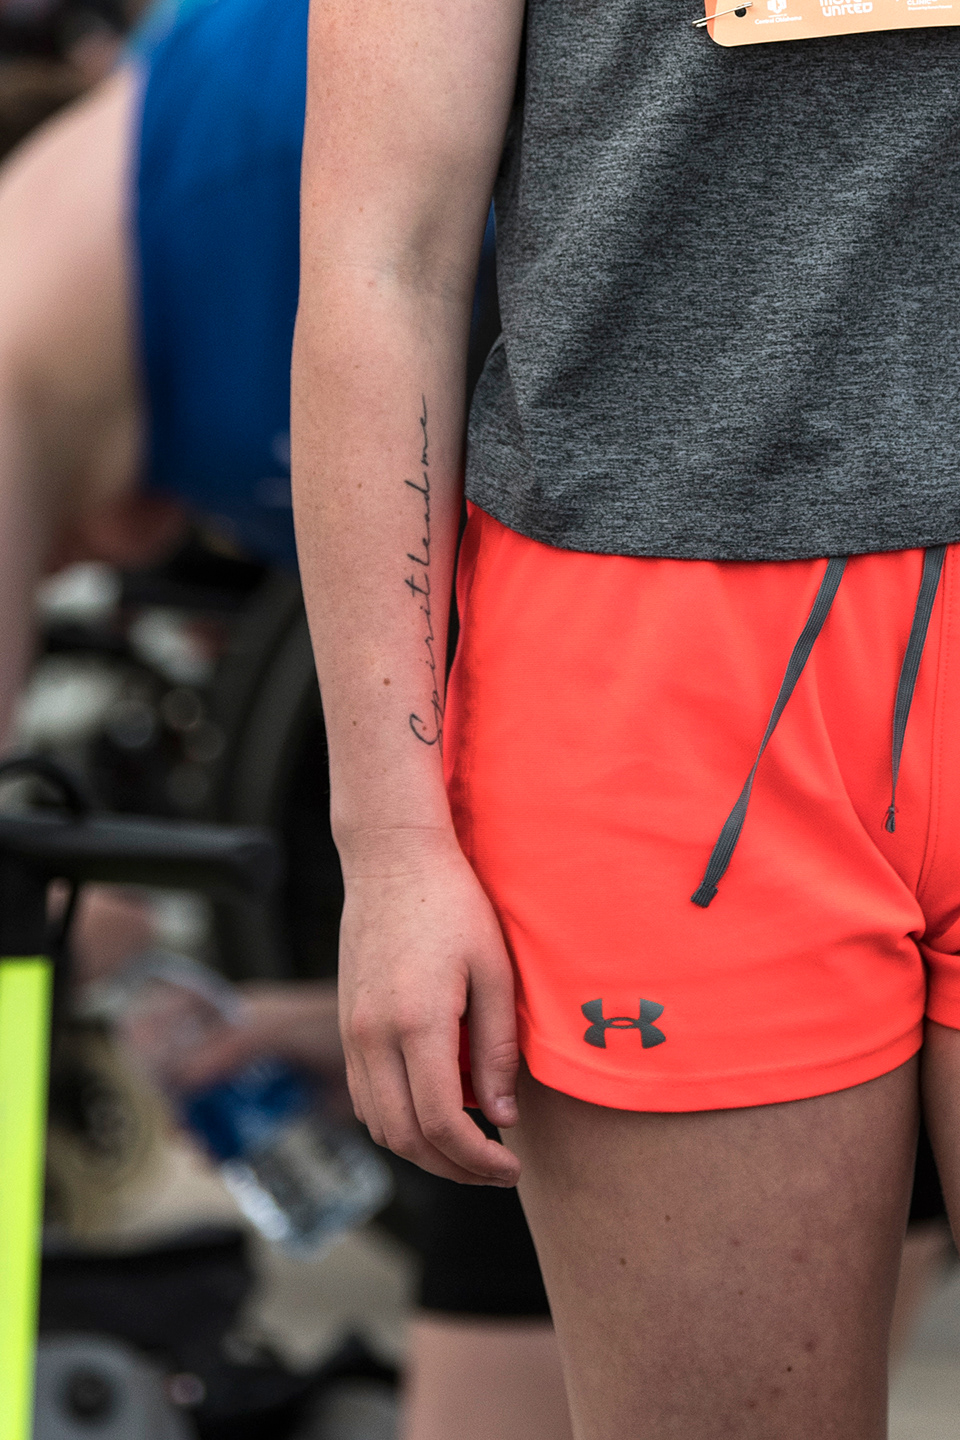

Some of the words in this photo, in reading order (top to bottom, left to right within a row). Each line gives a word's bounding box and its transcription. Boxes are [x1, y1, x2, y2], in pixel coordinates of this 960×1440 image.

[419, 393, 430, 467] me
[404, 471, 431, 567] lead
[405, 572, 444, 759] Spirit
